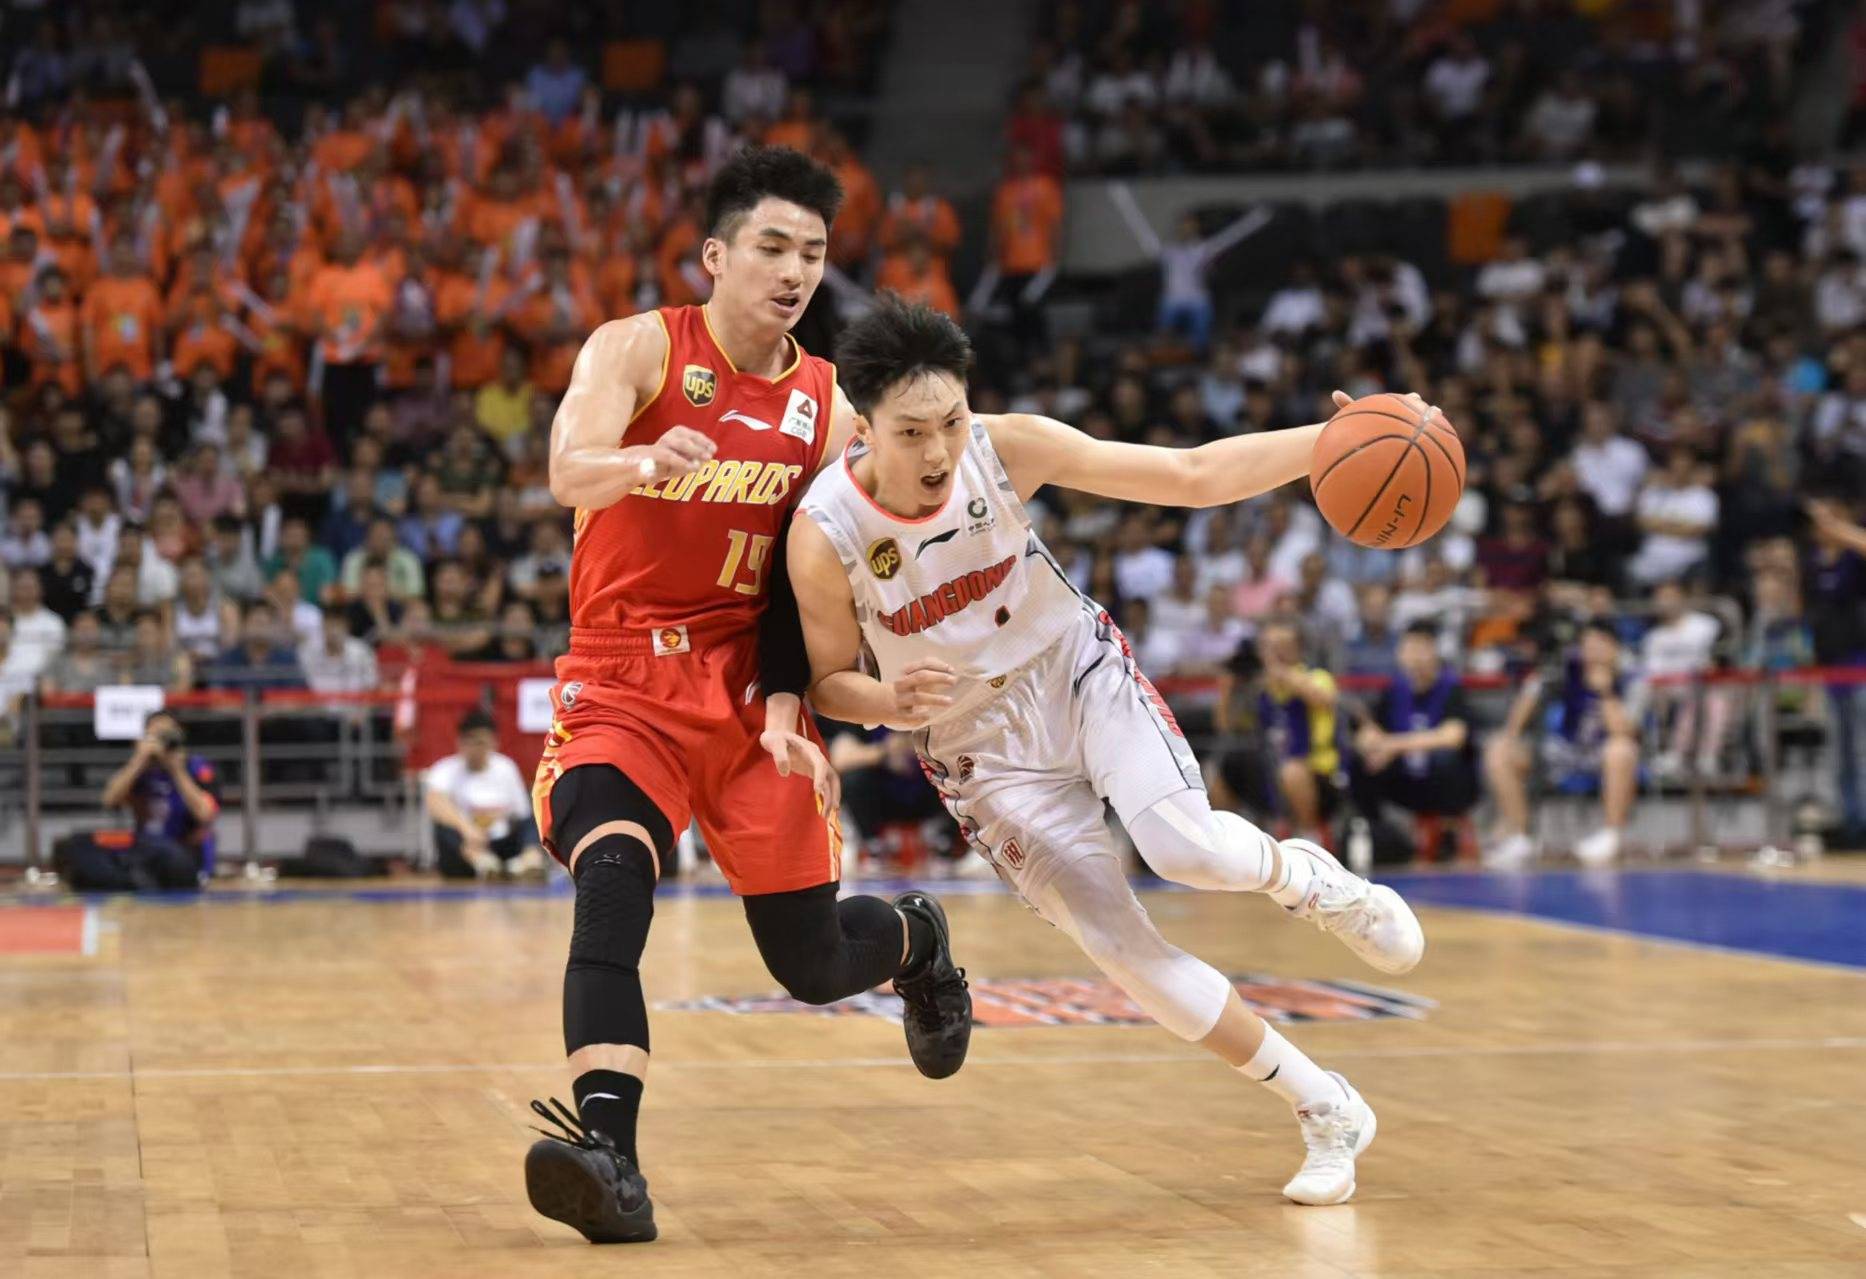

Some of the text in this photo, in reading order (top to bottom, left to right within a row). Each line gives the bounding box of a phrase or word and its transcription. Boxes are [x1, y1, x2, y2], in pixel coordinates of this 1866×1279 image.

[686, 376, 714, 400] ups
[629, 459, 803, 505] OPARDS
[871, 547, 898, 576] ups
